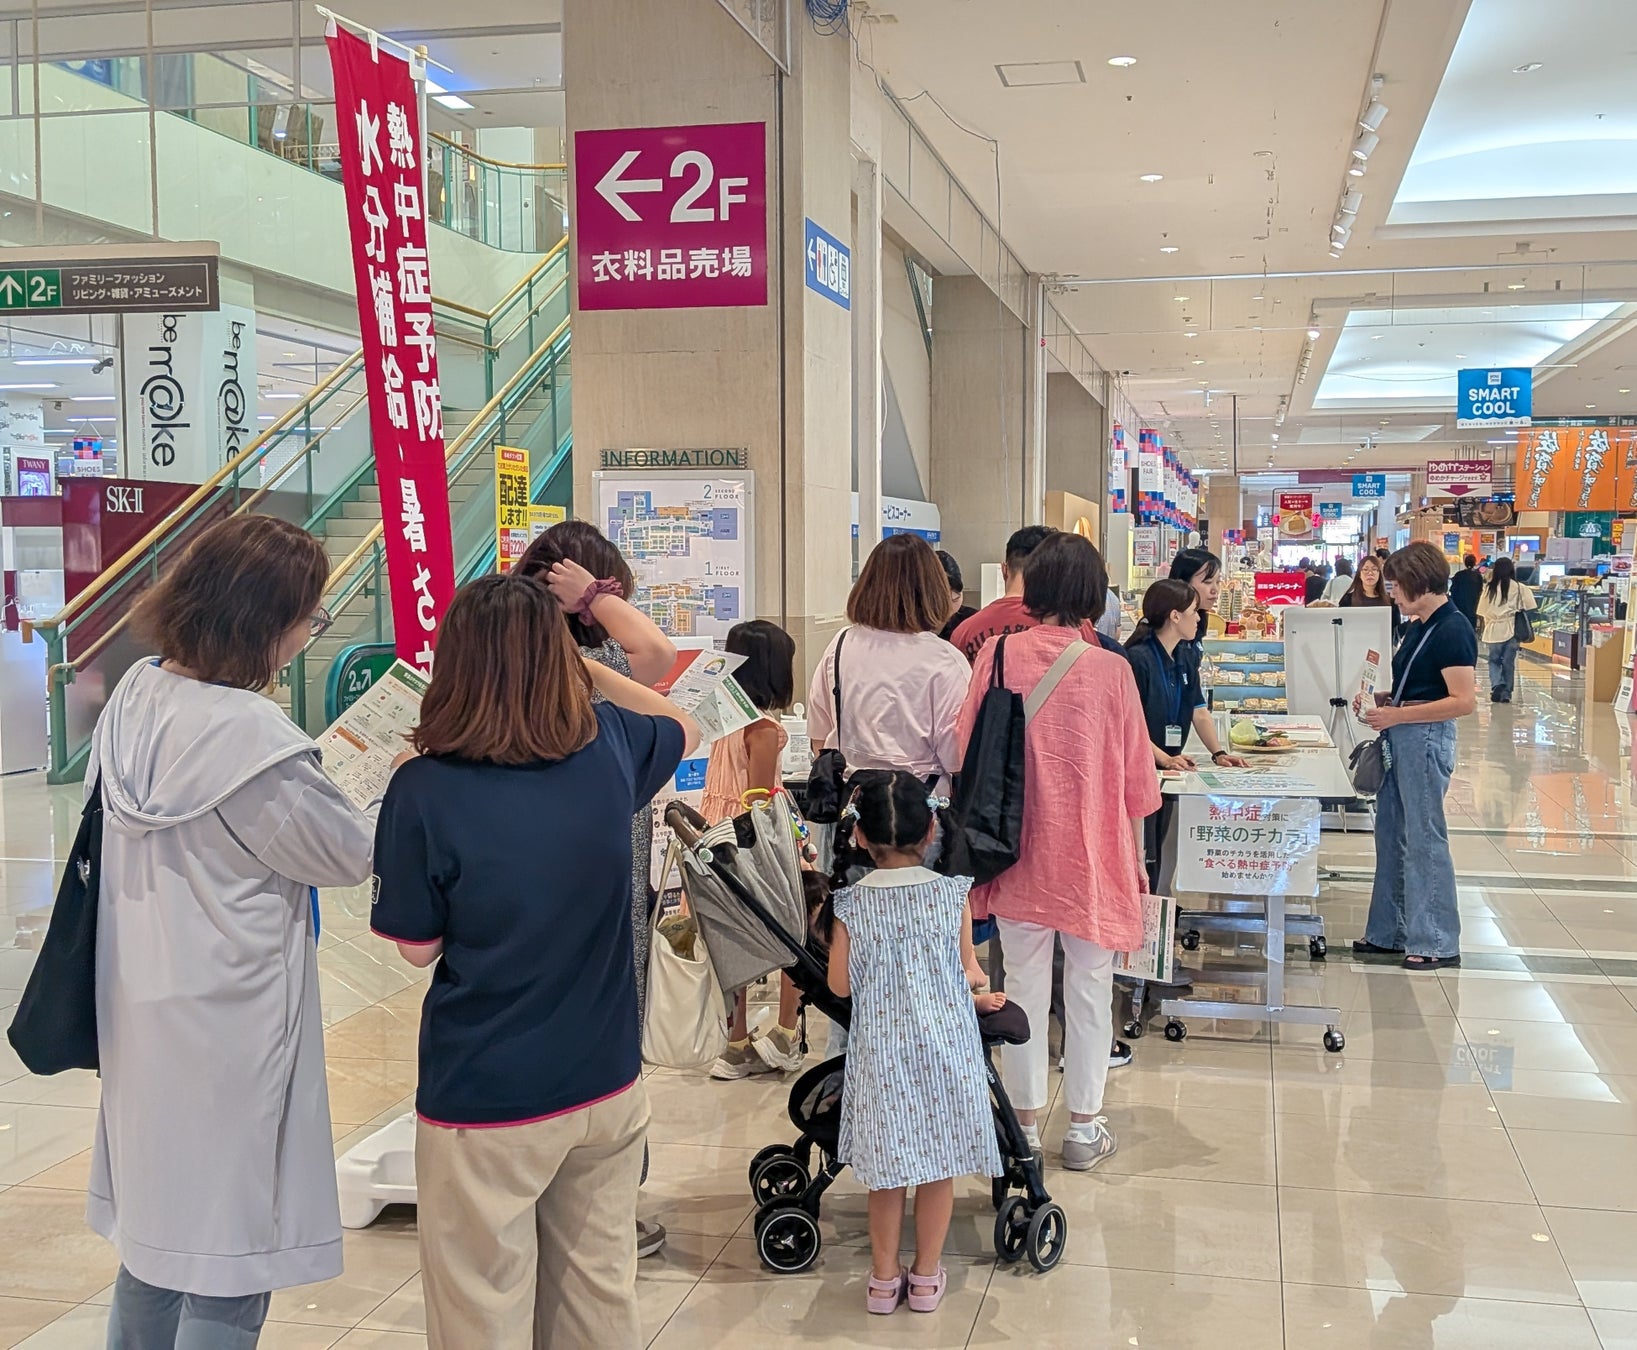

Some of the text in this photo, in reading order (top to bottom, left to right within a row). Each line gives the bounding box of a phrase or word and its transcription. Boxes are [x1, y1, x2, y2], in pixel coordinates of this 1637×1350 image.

[670, 150, 749, 223] 2F
[387, 101, 445, 441] 熱中症予防
[591, 246, 752, 282] 衣料品売場
[72, 273, 165, 285] ファミリーファッション
[30, 275, 57, 301] 2F
[72, 286, 203, 299] リビング・雑貨・アミューズメント
[1468, 387, 1520, 401] SMART
[1472, 401, 1516, 415] COOL
[23, 460, 46, 469] TWANY
[604, 450, 739, 467] INFORMATION
[1428, 462, 1491, 472] ゆめかステーション
[499, 473, 528, 506] 配達
[703, 484, 712, 499] 2
[107, 485, 144, 514] SK-II
[704, 561, 713, 575] 1
[1206, 848, 1290, 859] 野菜のチカラを活用した
